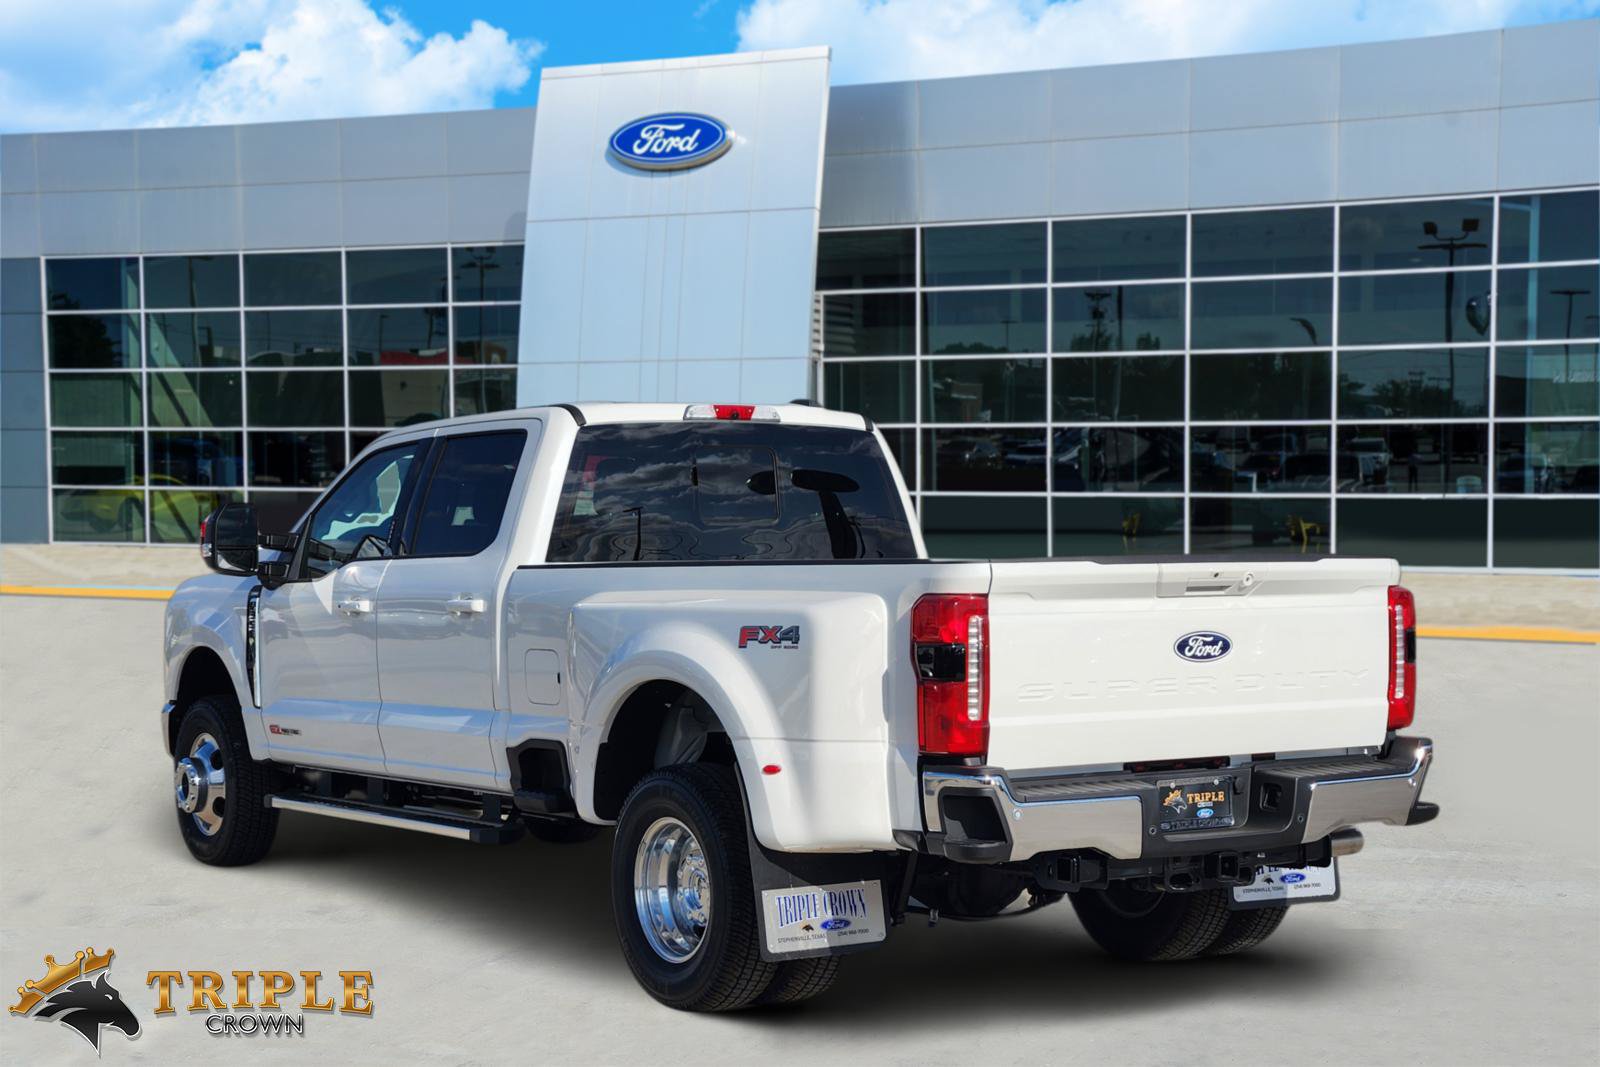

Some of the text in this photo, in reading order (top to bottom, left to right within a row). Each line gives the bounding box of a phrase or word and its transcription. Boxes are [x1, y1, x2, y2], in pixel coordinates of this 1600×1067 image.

[632, 123, 701, 155] Ford
[738, 625, 800, 648] FX4
[1184, 635, 1223, 657] Ford
[1016, 668, 1369, 702] SUPER DUTY
[1186, 791, 1225, 804] TRIPLE
[775, 888, 868, 928] TRIPLE CROWN
